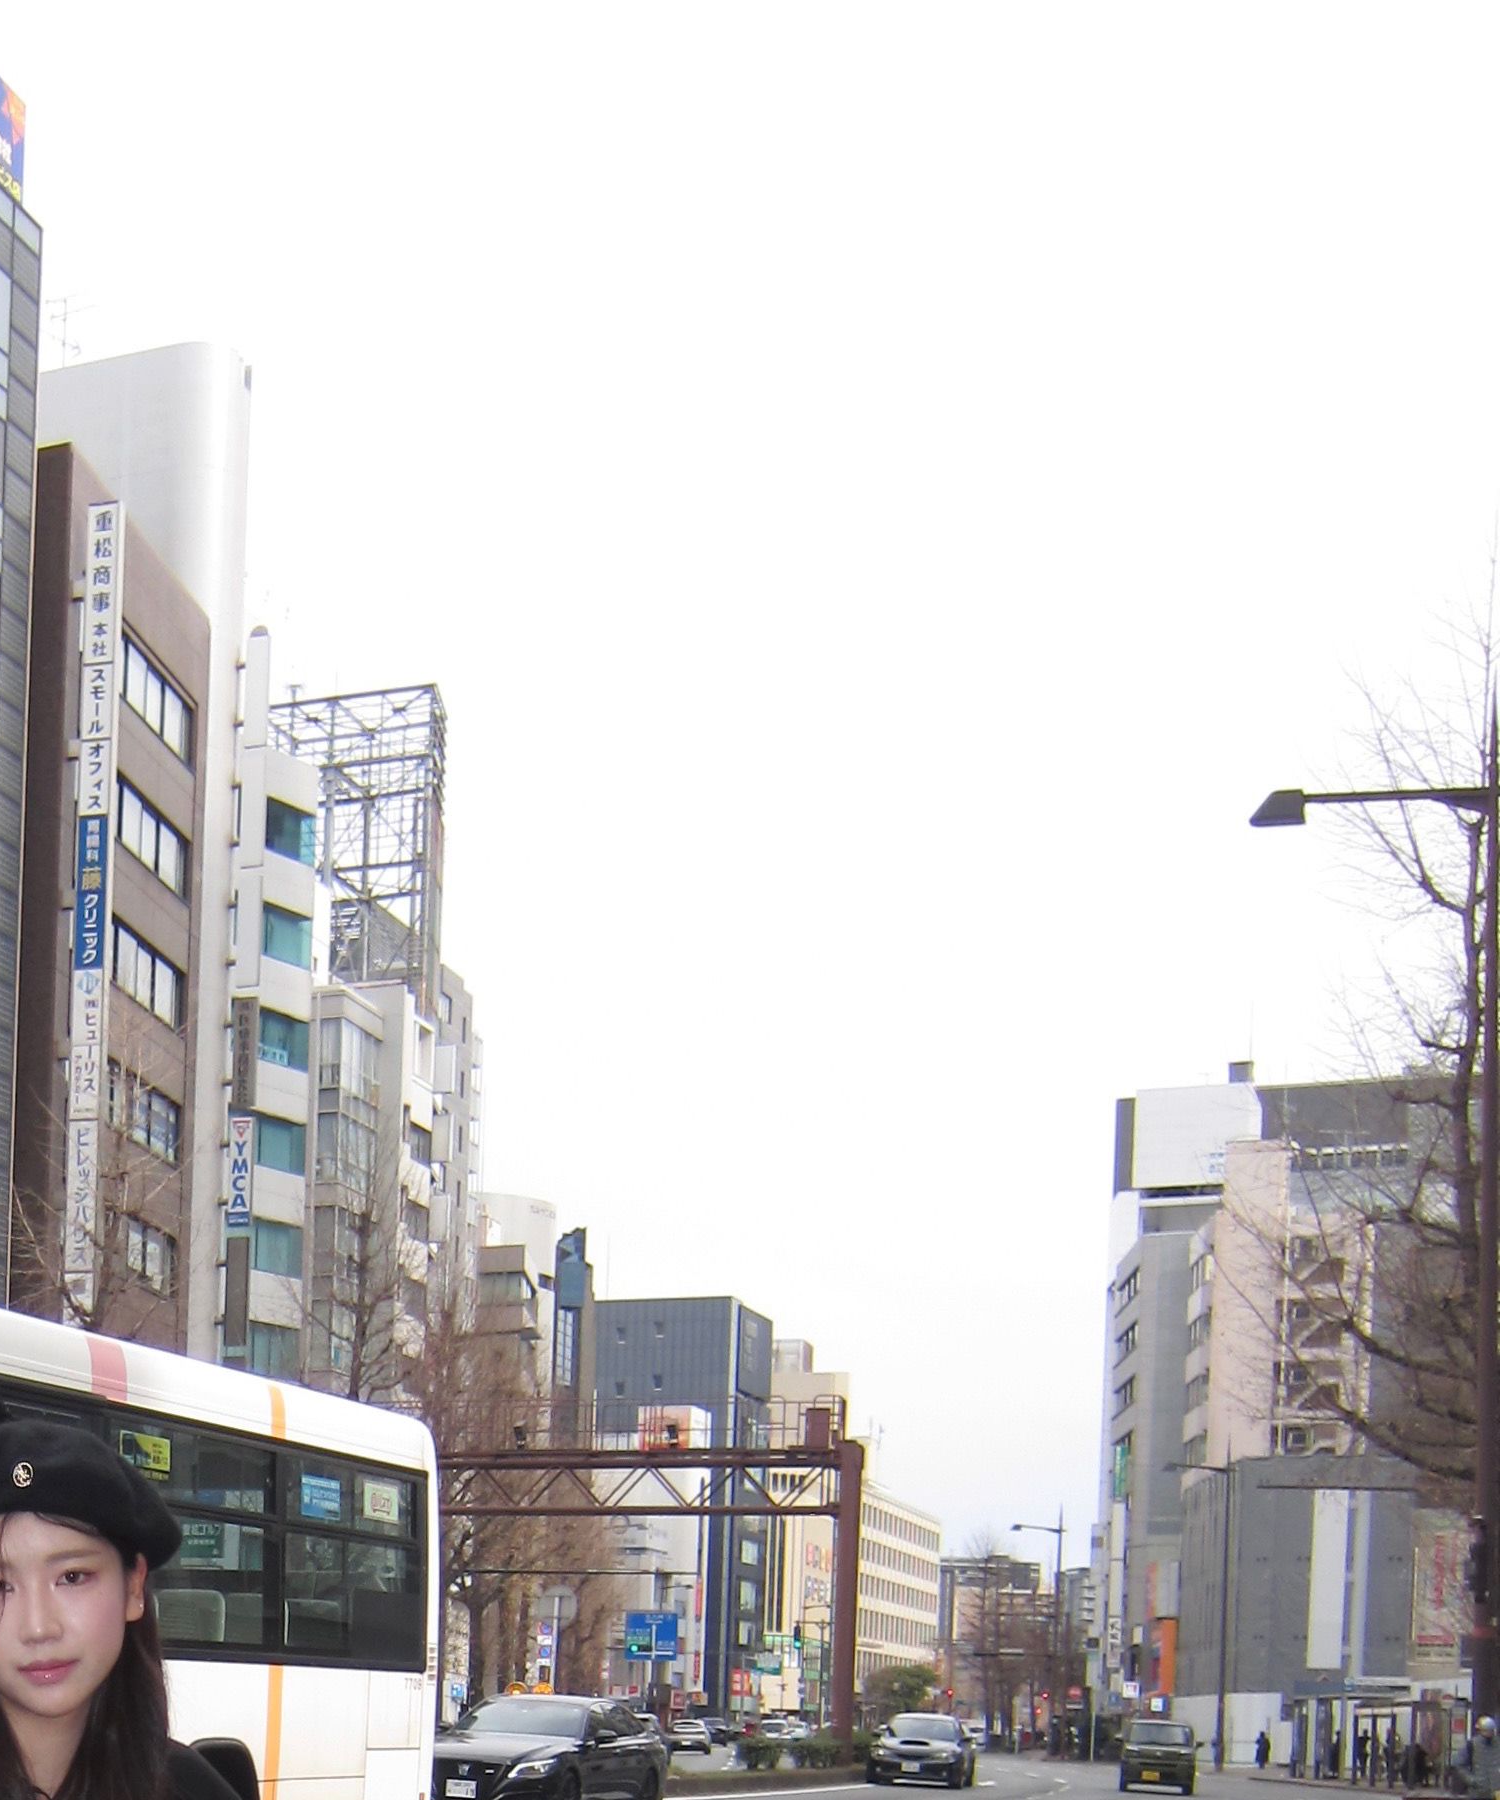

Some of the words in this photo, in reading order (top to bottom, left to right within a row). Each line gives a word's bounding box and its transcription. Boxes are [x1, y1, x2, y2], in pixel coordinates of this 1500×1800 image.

[88, 668, 106, 735] スモール
[88, 743, 105, 810] オフィス
[231, 1141, 248, 1210] YMCA
